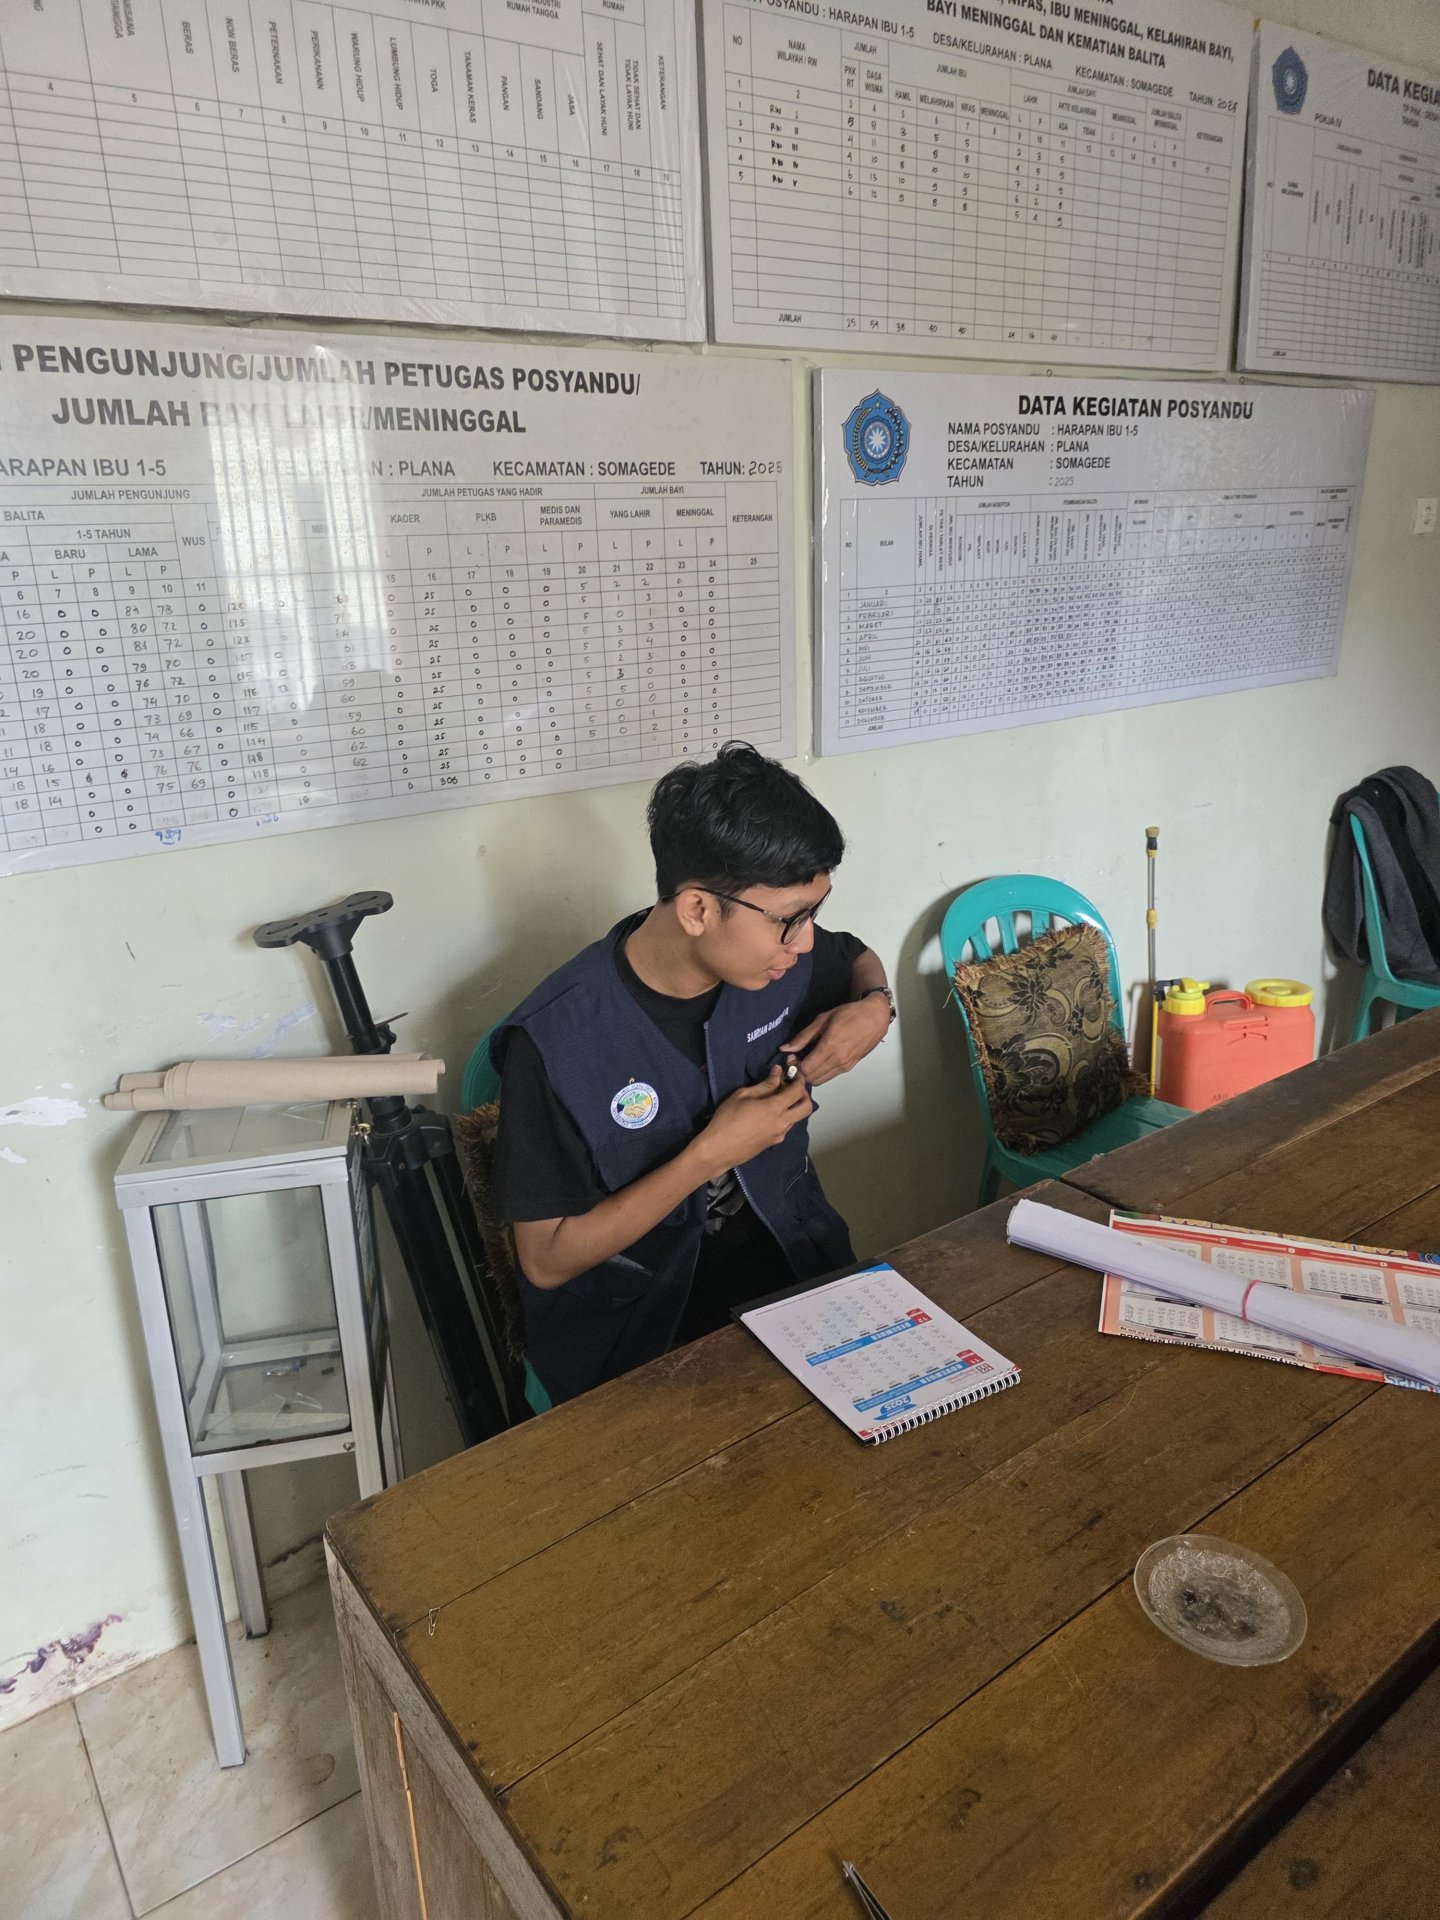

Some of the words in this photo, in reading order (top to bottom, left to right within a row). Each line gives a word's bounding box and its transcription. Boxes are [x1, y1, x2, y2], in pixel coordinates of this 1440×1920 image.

[506, 2, 530, 14] RUMAH
[532, 7, 559, 20] TANGGA
[602, 2, 624, 12] RUMAH
[225, 17, 235, 39] NON
[1048, 1, 1071, 19] IBU
[1074, 6, 1143, 39] MENINGGAL,
[1147, 26, 1206, 54] KELAHIRAN
[1208, 41, 1234, 63] BAYI,
[181, 20, 194, 55] BERAS
[732, 35, 743, 46] NO
[927, 0, 957, 18] BAYI
[961, 6, 1036, 37] MENINGGAL
[1039, 27, 1064, 43] DAN
[1067, 31, 1125, 57] KEMATIAN
[1128, 47, 1166, 69] BALITA
[788, 39, 806, 51] NAMA
[854, 41, 877, 55] JUMLAH
[229, 40, 240, 73] BERAS
[268, 21, 283, 84] PETERNAKAN
[596, 41, 605, 69] SEHAT
[777, 51, 803, 65] WILAYAH
[829, 8, 878, 31] HARAPAN
[881, 21, 898, 34] IBU
[901, 24, 915, 39] 1-5
[932, 31, 1017, 62] DESA/KELURAHAN
[1023, 52, 1052, 71] PLANA
[1075, 65, 1125, 87] KECAMATAN
[1131, 78, 1174, 98] SOMAGEDE
[1188, 91, 1215, 108] TAHUN:
[310, 30, 324, 90] PERIKANANN
[350, 32, 362, 73] WARUNG
[356, 75, 365, 102] HIDUP
[390, 36, 401, 82] LUMBUNG
[396, 83, 404, 110] HIDUP
[464, 51, 474, 95] TANAMAN
[844, 65, 857, 76] PKK
[429, 68, 438, 93] TOGA
[866, 69, 883, 82] DASA
[658, 55, 666, 110] KETERANGAN
[847, 78, 854, 89] RT
[864, 81, 884, 94] WISMA
[1367, 69, 1400, 95] DATA
[1403, 79, 1440, 107] KEGIA
[500, 76, 509, 111] PANGAN
[534, 78, 544, 120] SANDANG
[895, 89, 912, 102] HAMIL
[467, 95, 477, 124] KERAS
[567, 94, 576, 116] JASA
[360, 127, 370, 137] 10
[436, 139, 444, 148] 12
[540, 154, 547, 163] 15
[778, 313, 802, 324] JUMLAH
[12, 344, 376, 386] PENGUNJUNG/JUMLAH
[384, 361, 504, 391] PETUGAS
[513, 368, 641, 396] POSYANDU/
[51, 397, 191, 427] JUMLAH
[1018, 395, 1067, 416] DATA
[1072, 396, 1162, 417] KEGIATAN
[1167, 399, 1254, 419] POSYANDU
[948, 422, 981, 435] NAMA
[983, 423, 1040, 436] POSYANDU
[1057, 424, 1104, 436] HARAPAN
[1106, 425, 1122, 436] IBU
[1125, 425, 1138, 436] 1-5
[947, 440, 1045, 453] DESA/KELURAHAN
[1057, 441, 1089, 453] PLANA
[0, 459, 87, 477] ARAPAN
[95, 459, 129, 477] IBU
[137, 459, 166, 477] 1-5
[399, 461, 455, 477] PLANA
[493, 460, 585, 477] KECAMATAN
[598, 460, 676, 477] SOMAGEDE
[700, 461, 745, 476] TAHUN:
[947, 457, 1014, 470] KECAMATAN
[1055, 456, 1111, 469] SOMAGEDE
[947, 475, 984, 488] TAHUN
[1054, 476, 1075, 487] 2025
[71, 490, 115, 501] JUMLAH
[118, 489, 190, 501] PENGUNJUNG
[421, 487, 454, 498] JUMLAH
[455, 486, 495, 498] PETUGAS
[496, 486, 518, 497] YANG
[519, 486, 543, 497] HADIR
[641, 485, 667, 496] JUMLAH
[669, 485, 684, 496] BAYI
[4, 510, 45, 522] BALITA
[540, 505, 563, 516] MEDIS
[565, 505, 581, 515] DAN
[609, 508, 629, 519] YANG
[630, 507, 651, 519] LAHIR
[676, 507, 714, 518] MENINGGAL
[390, 513, 420, 525] KADER
[475, 512, 497, 523] PLKB
[540, 515, 582, 527] PARAMEDIS
[732, 513, 773, 525] KETERANGAN
[76, 530, 91, 540] 1-5
[94, 528, 131, 540] TAHUN
[182, 536, 206, 546] WUS
[54, 549, 86, 561] BARU
[128, 547, 159, 558] LAMA
[613, 564, 621, 573] 21
[428, 571, 437, 582] 16
[162, 584, 173, 593] 10
[858, 611, 893, 620] FEBRUARI
[131, 623, 147, 634] 80
[858, 621, 883, 630] MARET
[17, 630, 36, 640] 20
[132, 662, 147, 672] 79
[171, 676, 186, 686] 72
[432, 671, 442, 680] 25
[178, 711, 192, 721] 69
[34, 723, 46, 734] 18
[885, 1395, 912, 1412] 2025
